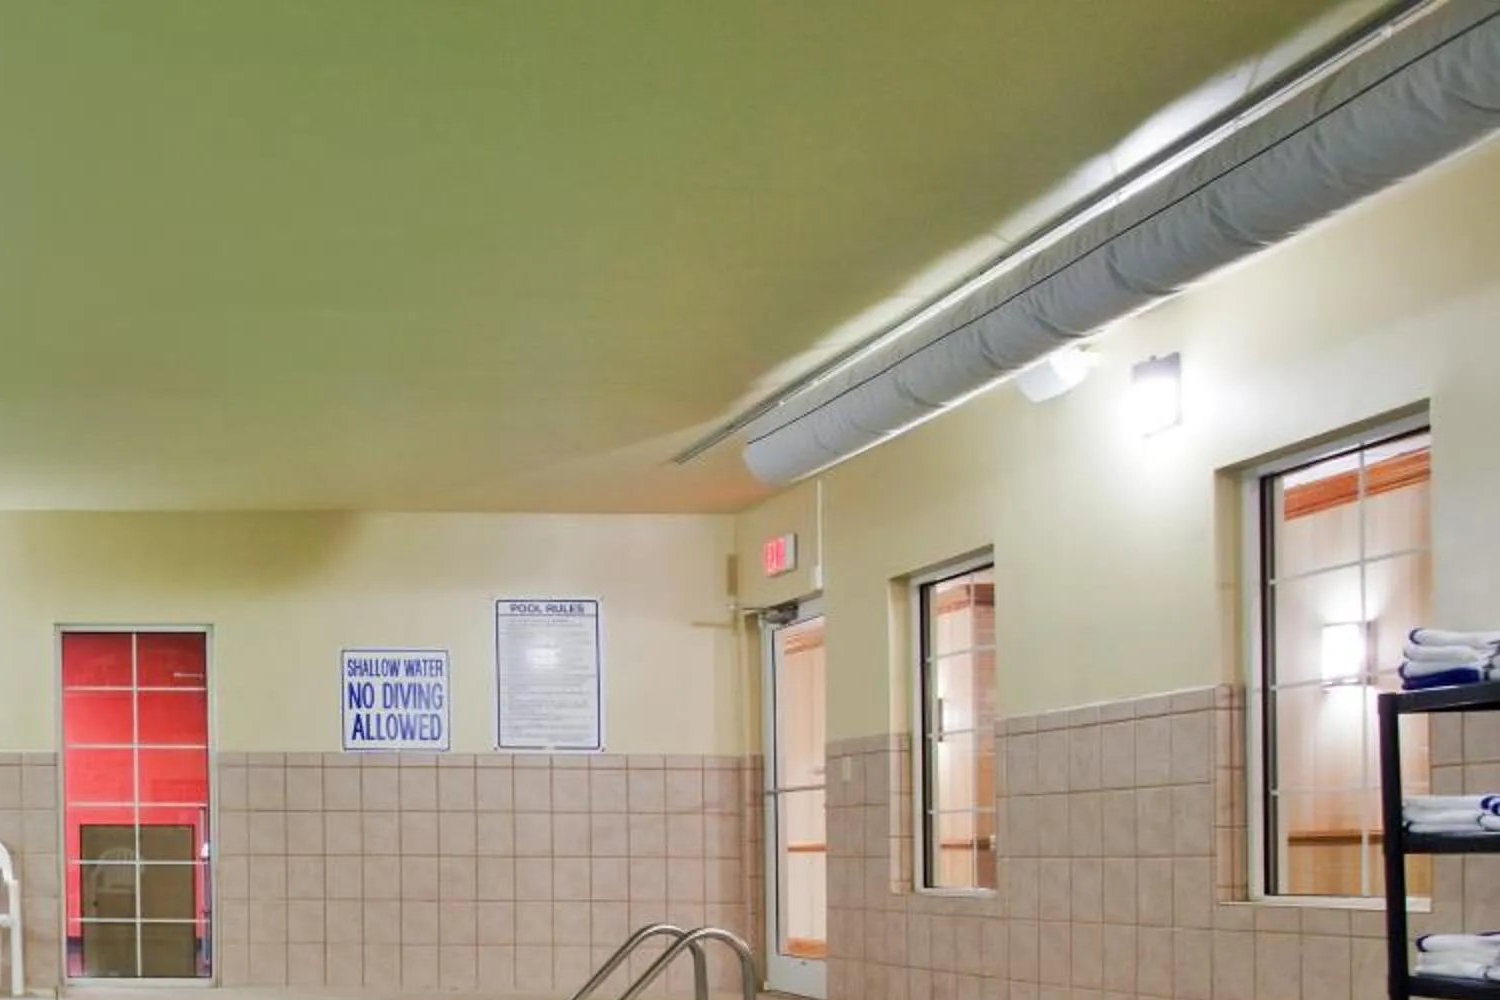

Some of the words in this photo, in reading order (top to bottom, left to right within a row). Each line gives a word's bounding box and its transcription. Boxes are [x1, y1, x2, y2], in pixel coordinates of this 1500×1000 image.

[509, 603, 542, 613] POOL
[546, 603, 585, 614] RULES
[347, 658, 400, 677] SHALLOW
[404, 658, 443, 677] WATER
[348, 681, 375, 709] NO
[382, 681, 444, 710] DIVING
[351, 713, 442, 741] ALLOWED
